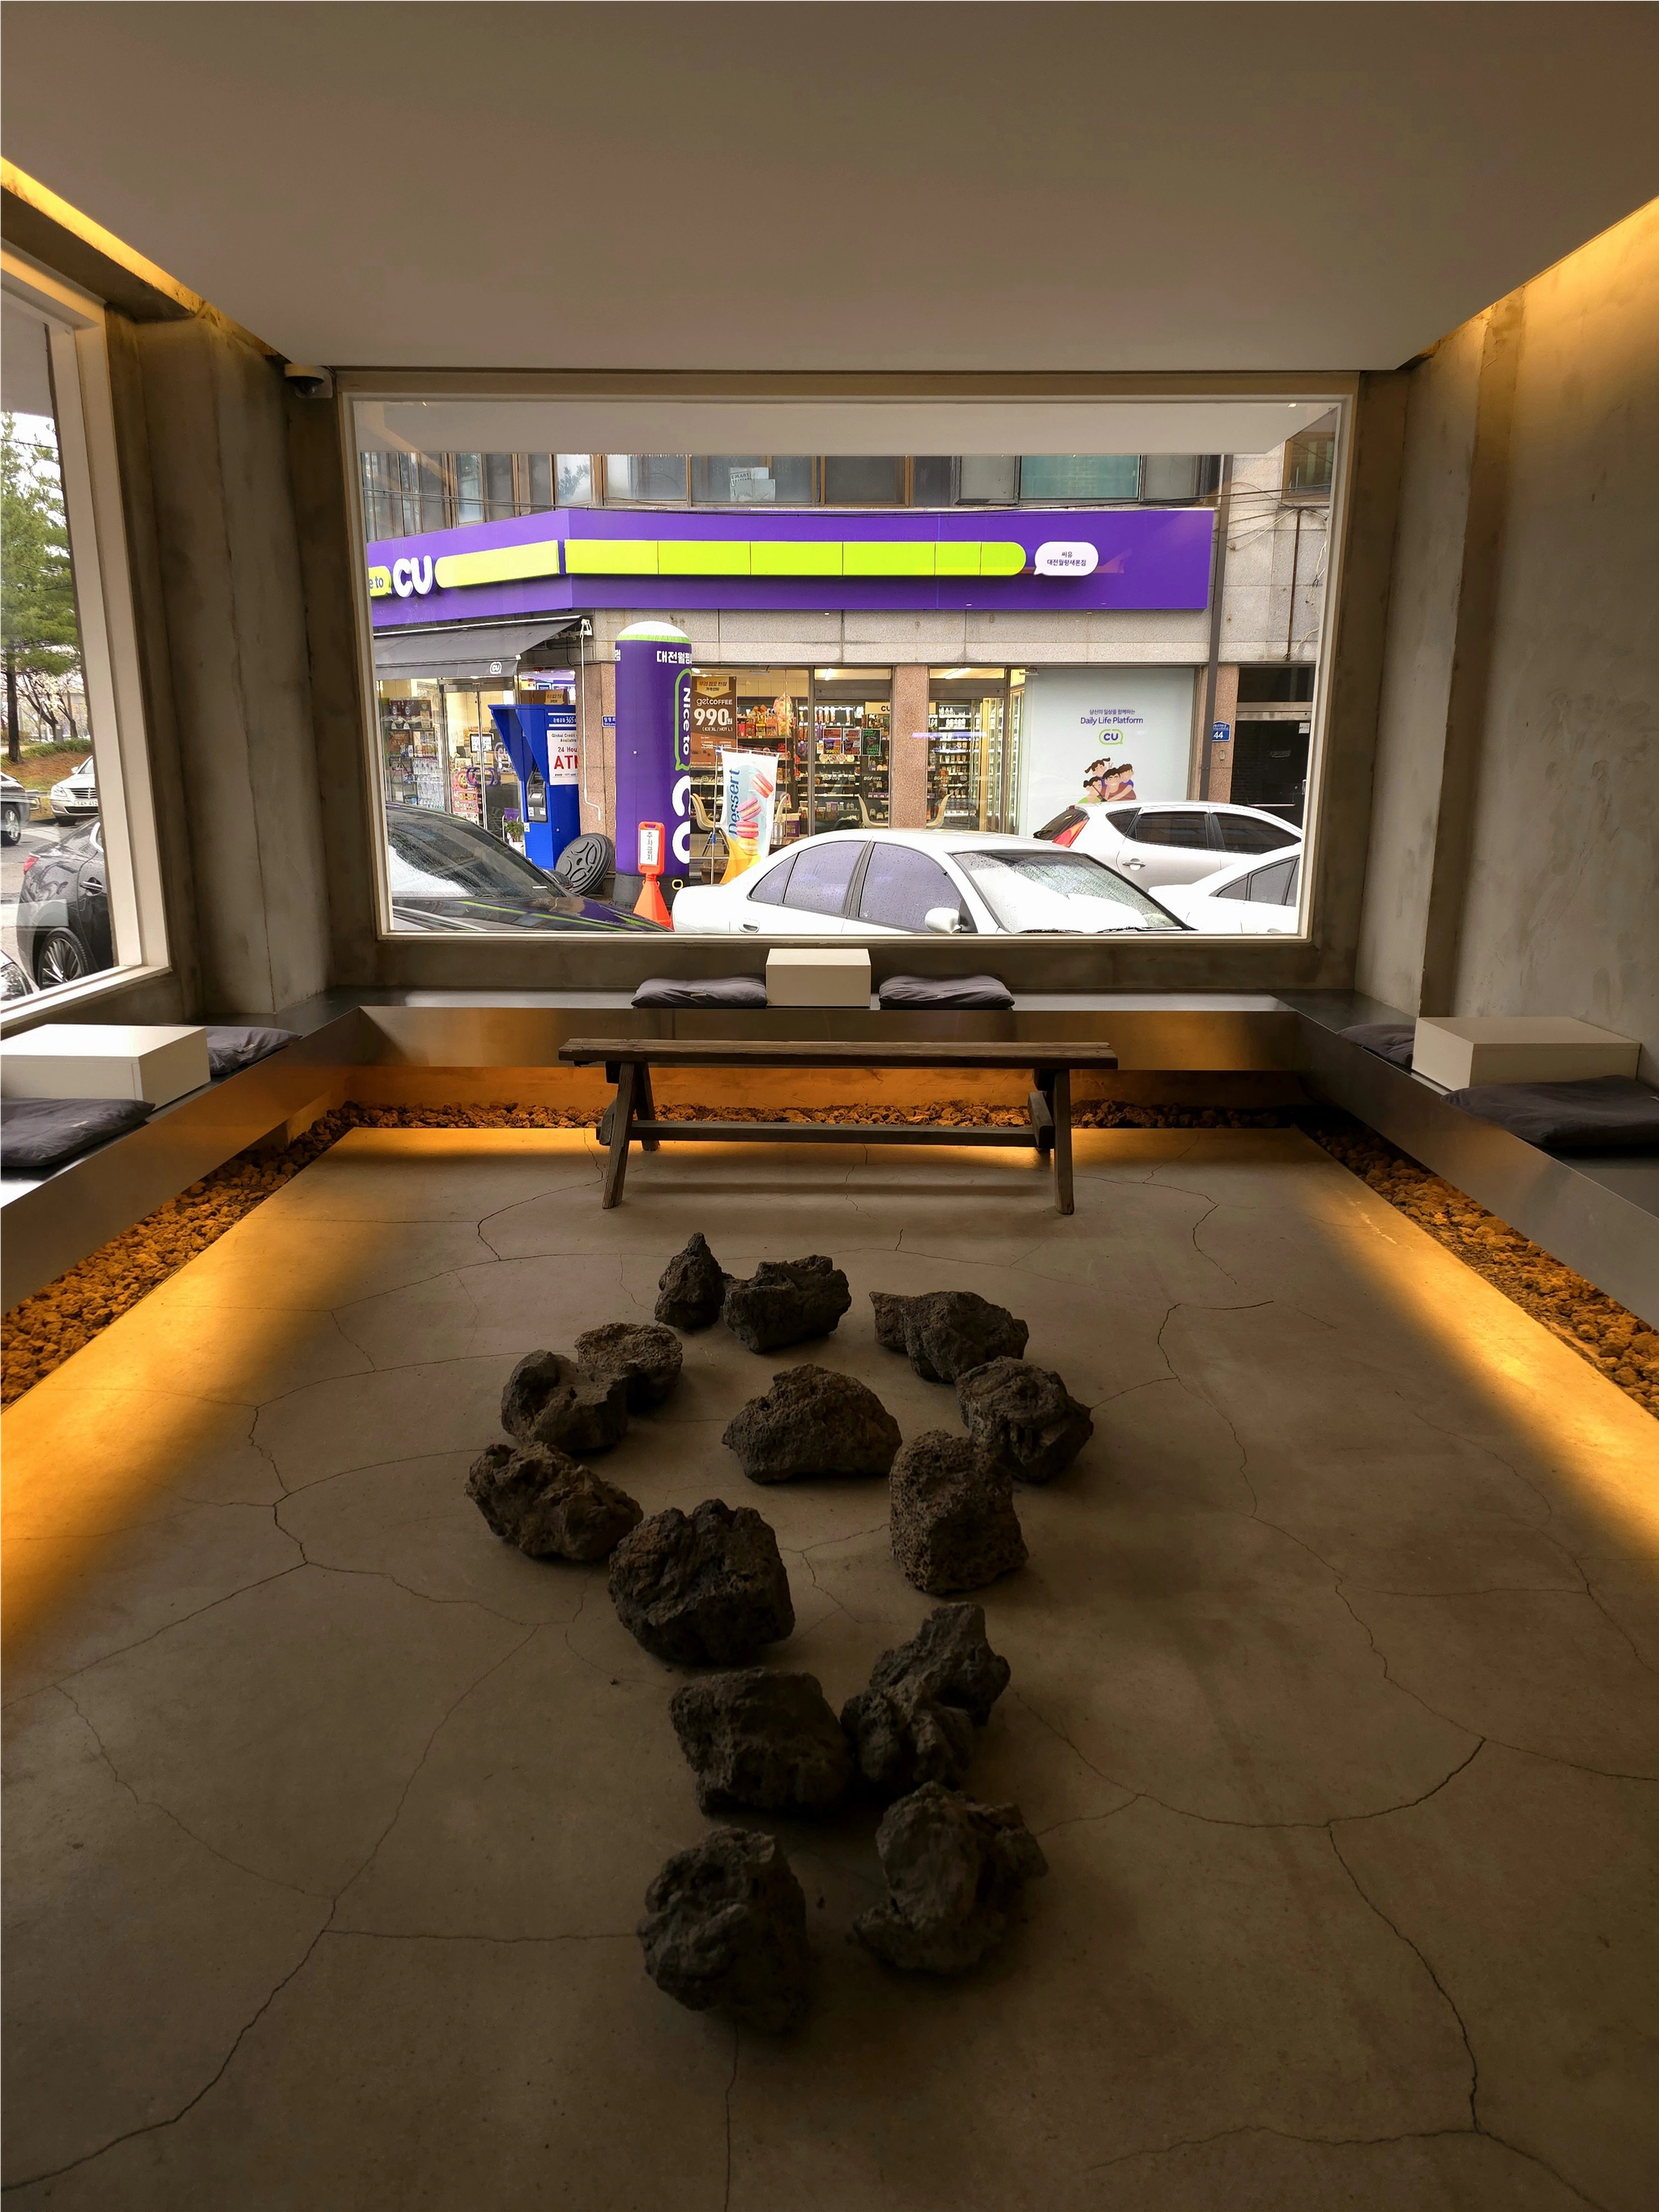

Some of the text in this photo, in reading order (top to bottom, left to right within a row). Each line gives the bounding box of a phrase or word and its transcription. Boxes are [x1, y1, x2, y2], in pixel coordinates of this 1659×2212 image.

[375, 576, 384, 589] to
[393, 555, 433, 598] CU
[656, 650, 692, 665] 대전월평
[683, 687, 691, 756] Nice to
[1081, 717, 1098, 726] Daily
[1102, 733, 1119, 741] CU
[1213, 731, 1224, 739] 44
[728, 769, 740, 836] Dessert
